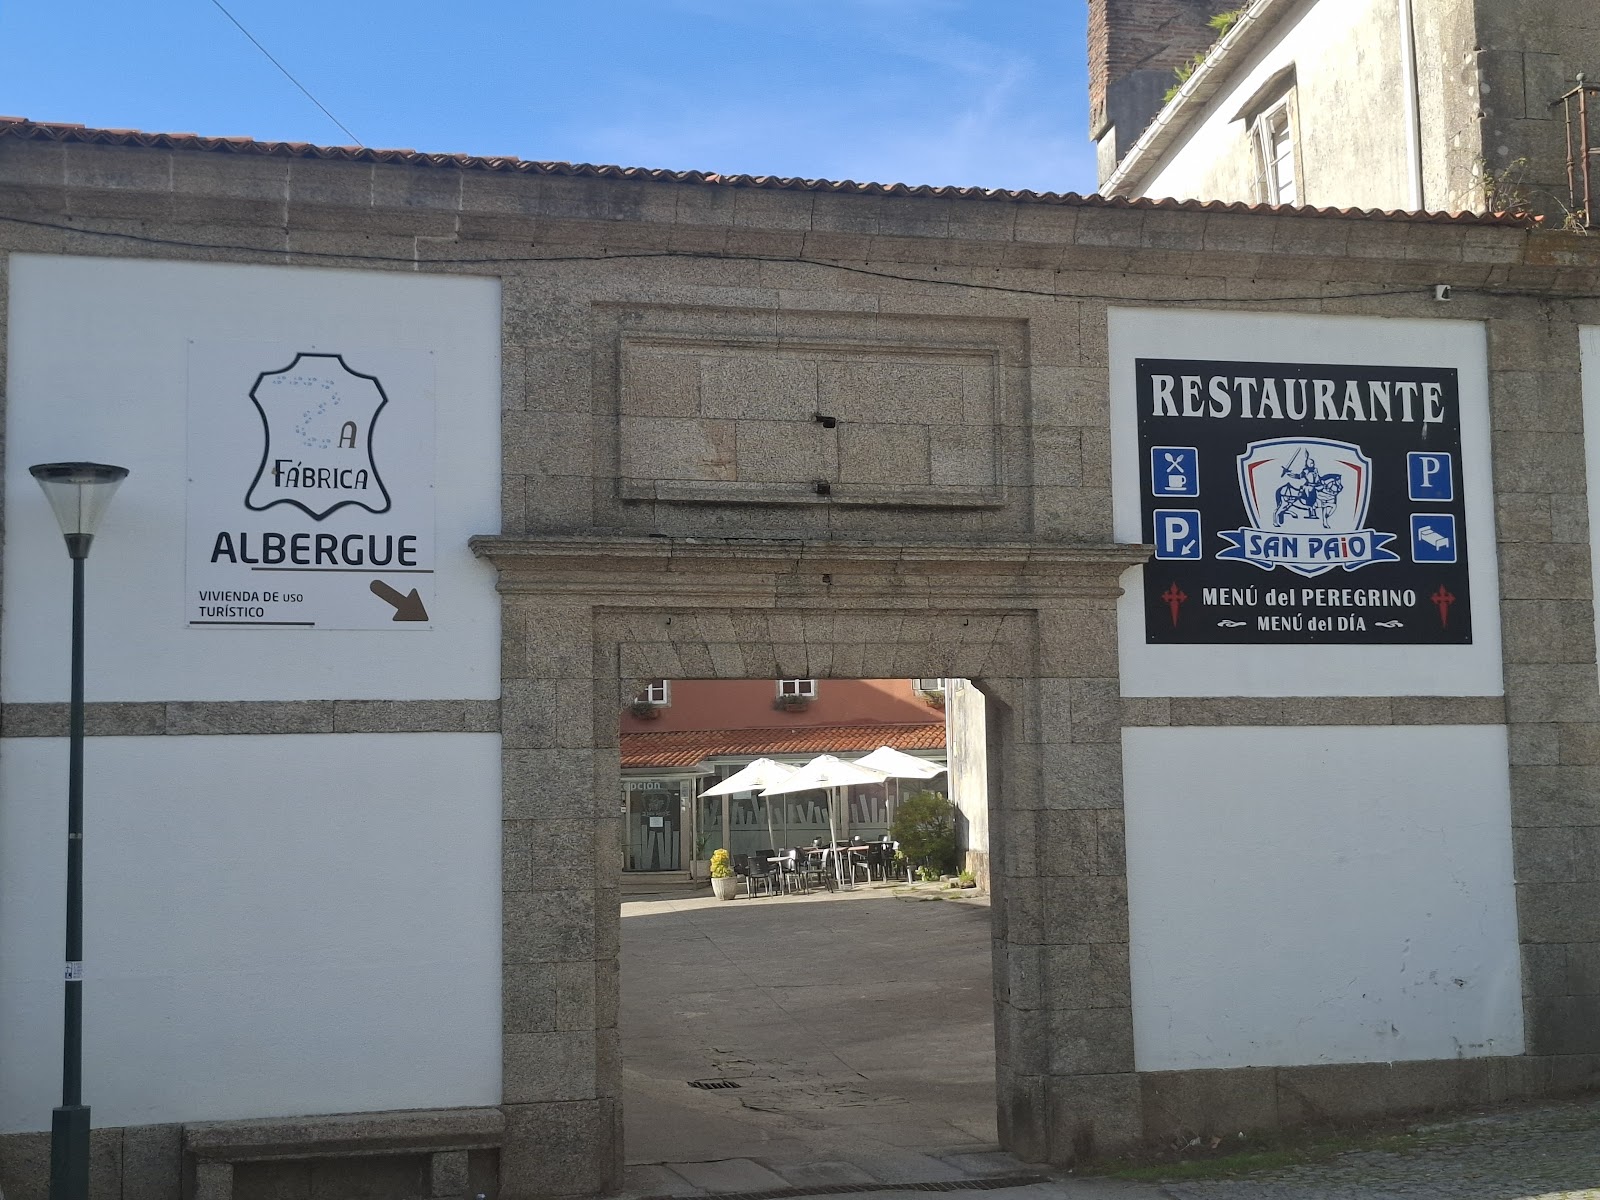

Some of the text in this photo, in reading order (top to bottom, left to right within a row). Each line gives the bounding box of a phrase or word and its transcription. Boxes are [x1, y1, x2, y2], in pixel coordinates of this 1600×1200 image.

[1151, 374, 1444, 424] RESTAURANTE
[337, 421, 357, 448] A
[274, 459, 369, 490] FÁBRICA
[1419, 457, 1440, 487] P
[1165, 517, 1189, 553] P
[1250, 535, 1298, 560] SAN
[211, 532, 417, 566] ALBERGUE
[199, 591, 260, 602] VIVIENDA
[263, 591, 279, 602] DE
[1203, 585, 1416, 608] MENÚ del PEREGRINO
[199, 604, 264, 618] TURÍSTICO
[1257, 613, 1366, 632] MENÚ del DÍA
